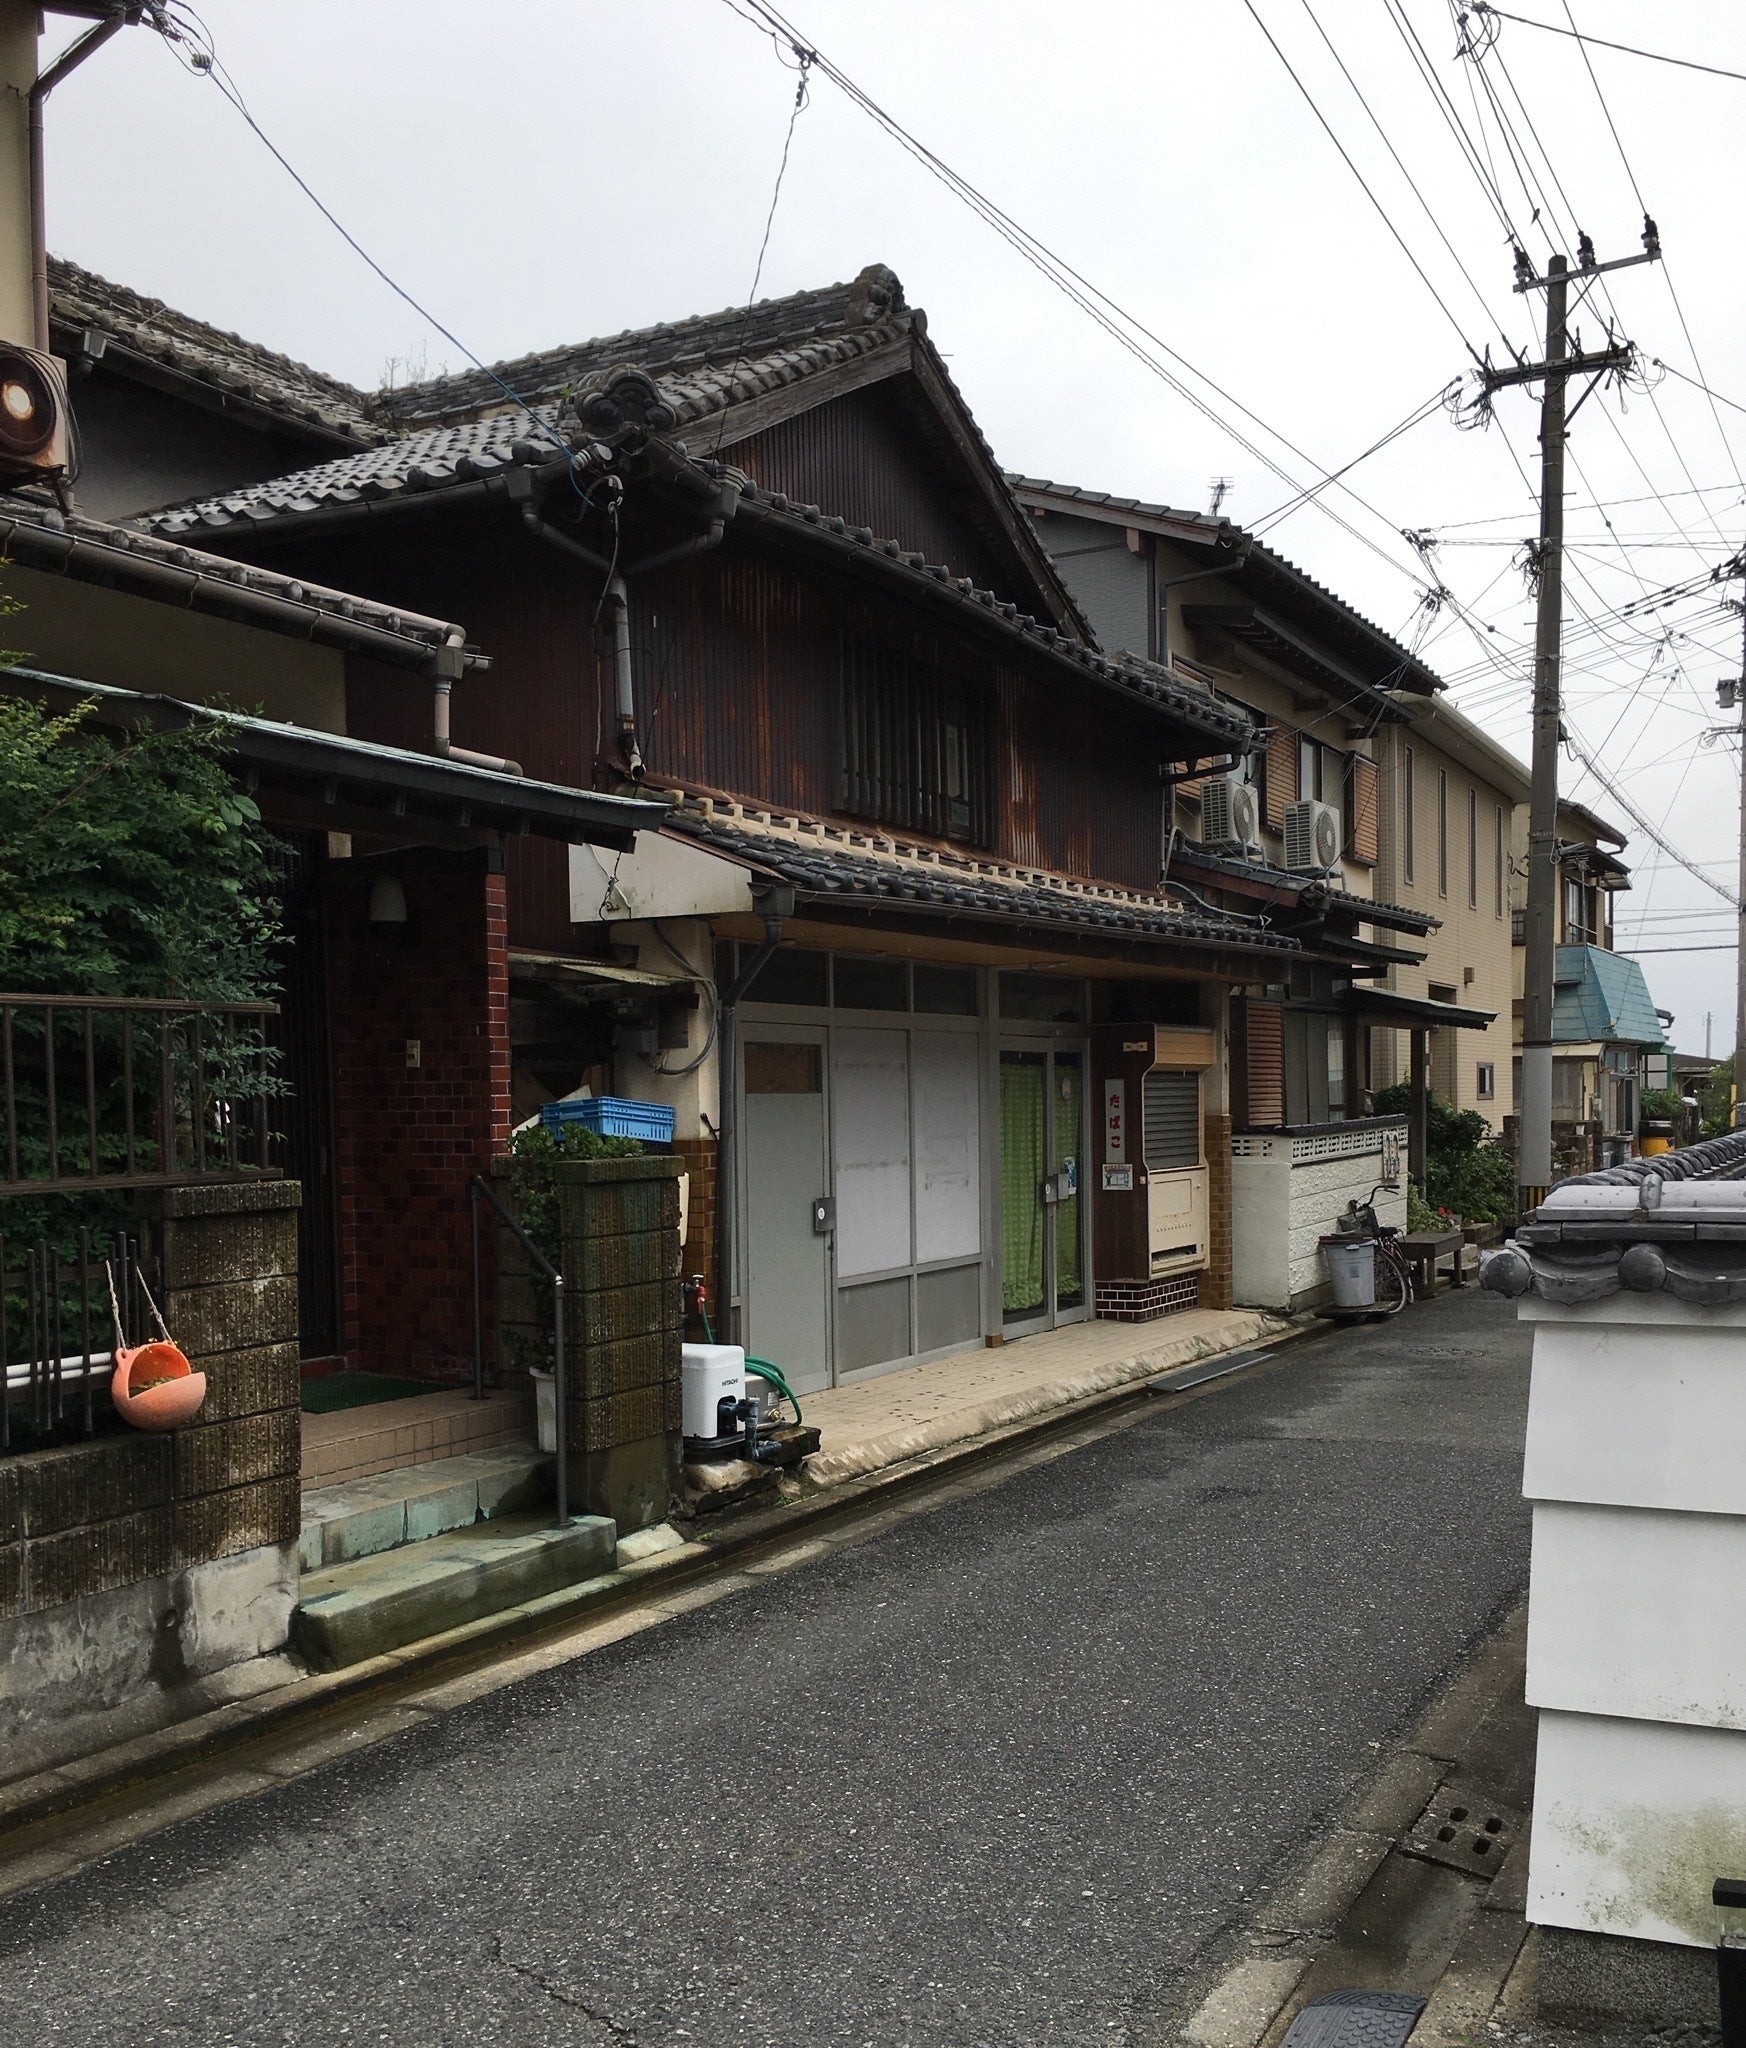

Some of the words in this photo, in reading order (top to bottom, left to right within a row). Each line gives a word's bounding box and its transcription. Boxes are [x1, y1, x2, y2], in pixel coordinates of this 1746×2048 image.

[1109, 1094, 1121, 1148] たばこ
[722, 1378, 738, 1386] HITACHI
